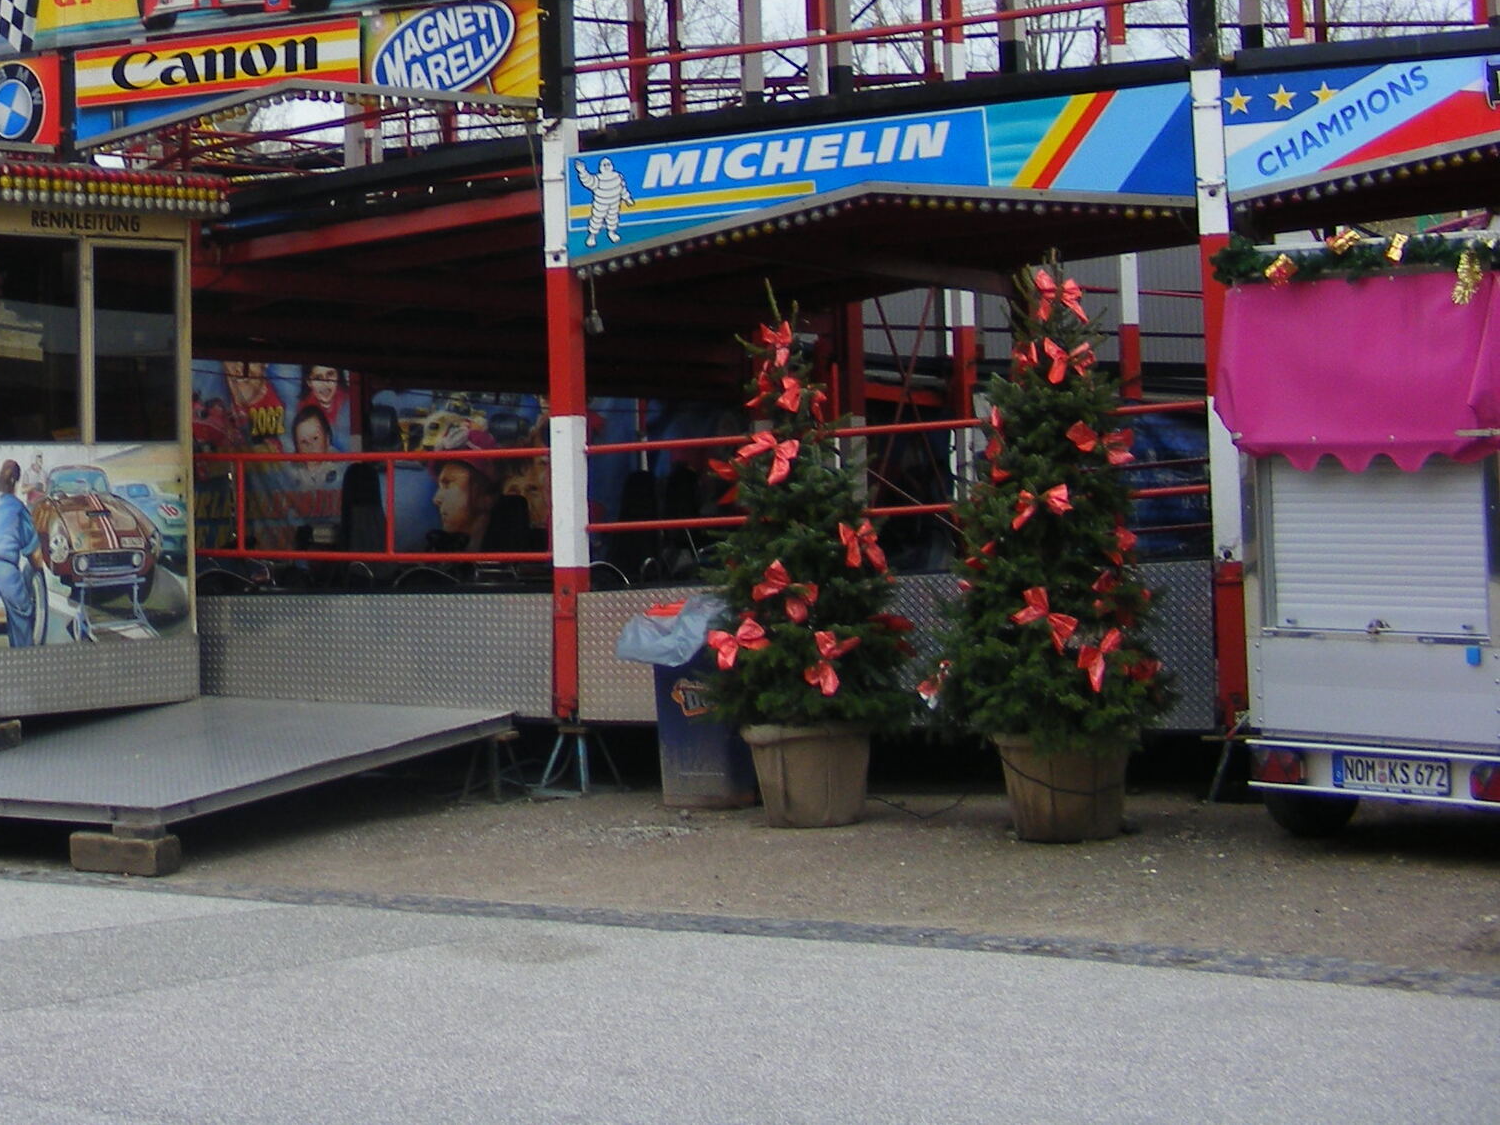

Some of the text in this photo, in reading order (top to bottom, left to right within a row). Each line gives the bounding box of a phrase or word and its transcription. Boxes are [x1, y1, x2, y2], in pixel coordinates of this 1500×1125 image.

[111, 36, 318, 90] Canon
[384, 3, 501, 75] MAGNETI
[1257, 65, 1430, 177] CHAMPIONS
[641, 120, 951, 191] MICHELIN
[31, 210, 141, 233] RENNLEITUNG
[250, 406, 286, 436] 2002
[1343, 758, 1446, 787] NOM KS 672
